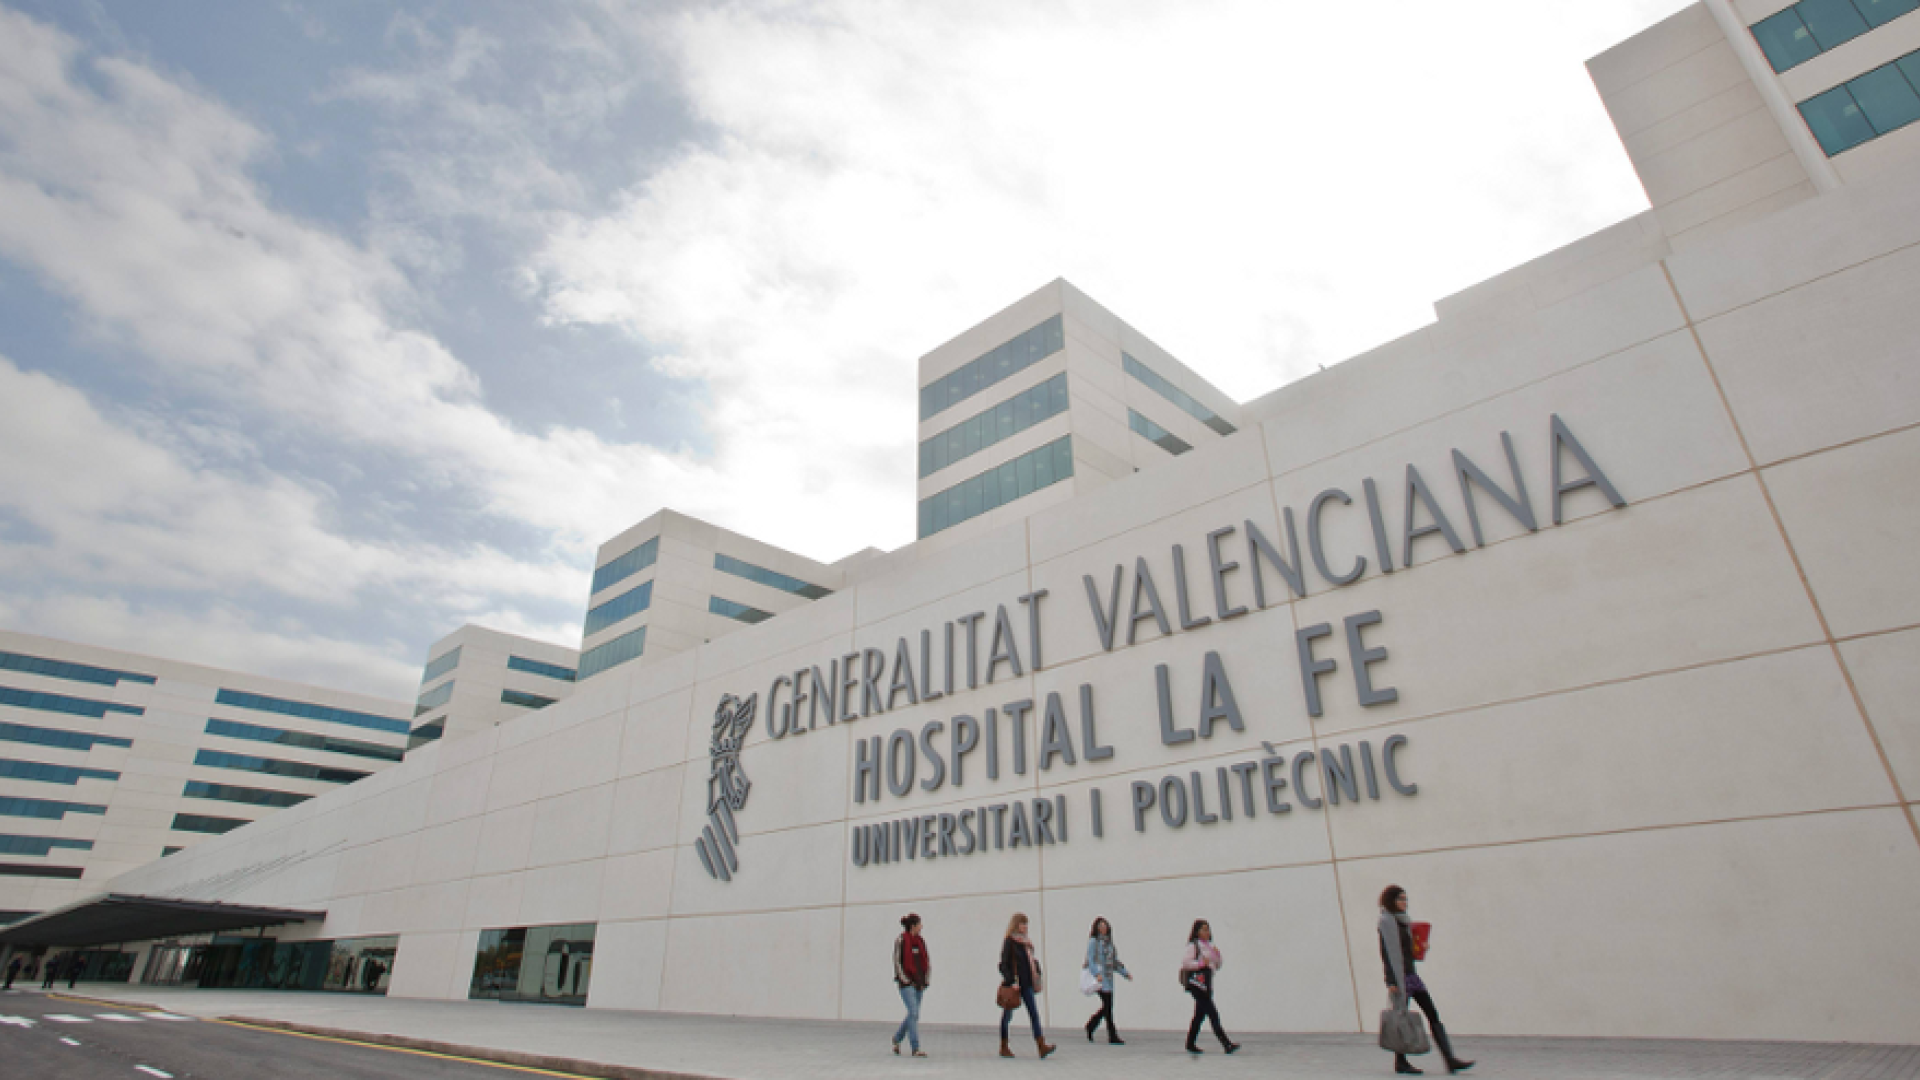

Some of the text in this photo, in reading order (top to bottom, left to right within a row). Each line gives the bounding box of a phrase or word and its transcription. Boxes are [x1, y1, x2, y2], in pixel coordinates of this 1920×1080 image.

[767, 414, 1626, 740] GENERALITAT VALENCIANA
[853, 735, 1417, 867] UNIVERSITARI I POLITÈCNIC
[854, 610, 1398, 803] HOSPITAL LA FE
